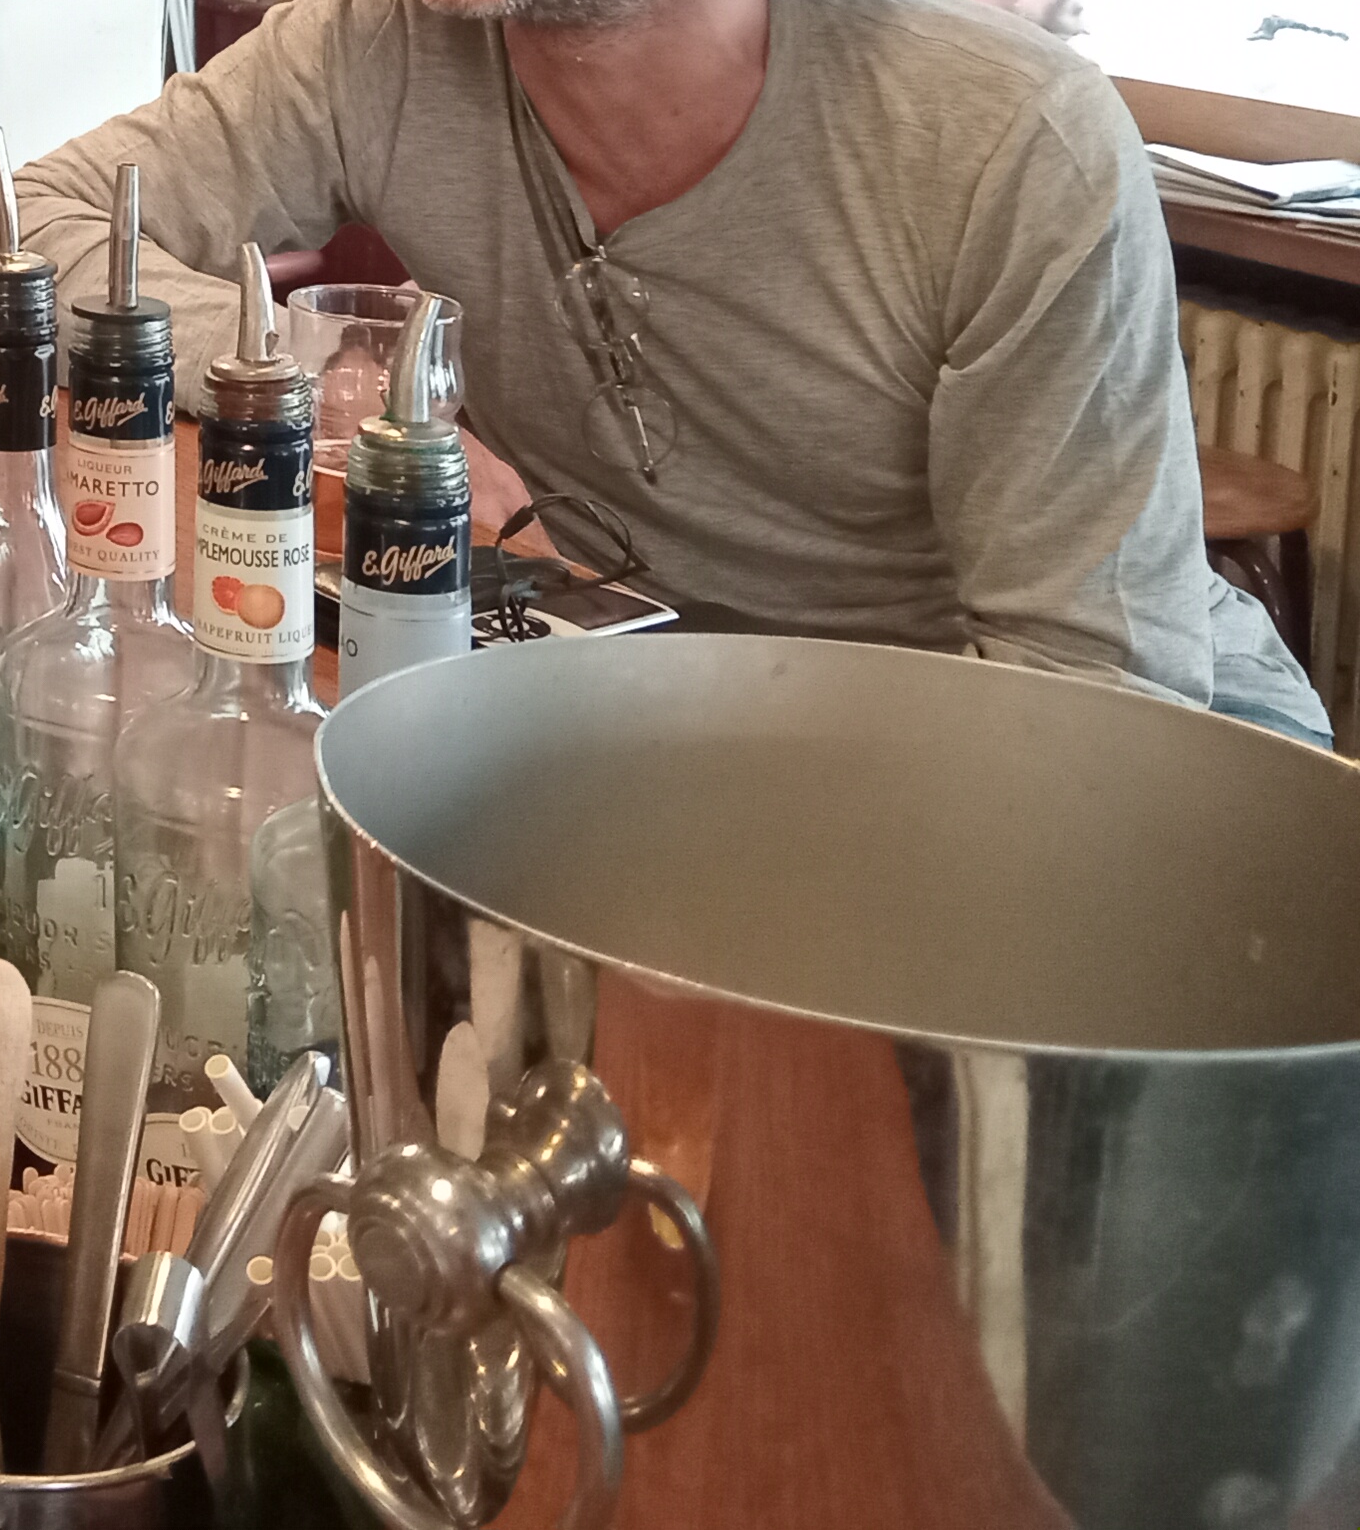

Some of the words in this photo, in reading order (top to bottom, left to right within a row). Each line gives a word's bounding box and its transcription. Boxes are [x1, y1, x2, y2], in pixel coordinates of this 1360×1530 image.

[77, 459, 133, 475] LIQUEUR
[202, 524, 257, 544] CRÈME
[265, 533, 288, 544] DE
[98, 549, 161, 563] QUALITY
[197, 539, 279, 568] PLEMOUSSE
[284, 543, 310, 565] ROSE
[196, 617, 273, 645] APEFRUIT
[30, 1040, 84, 1083] 188
